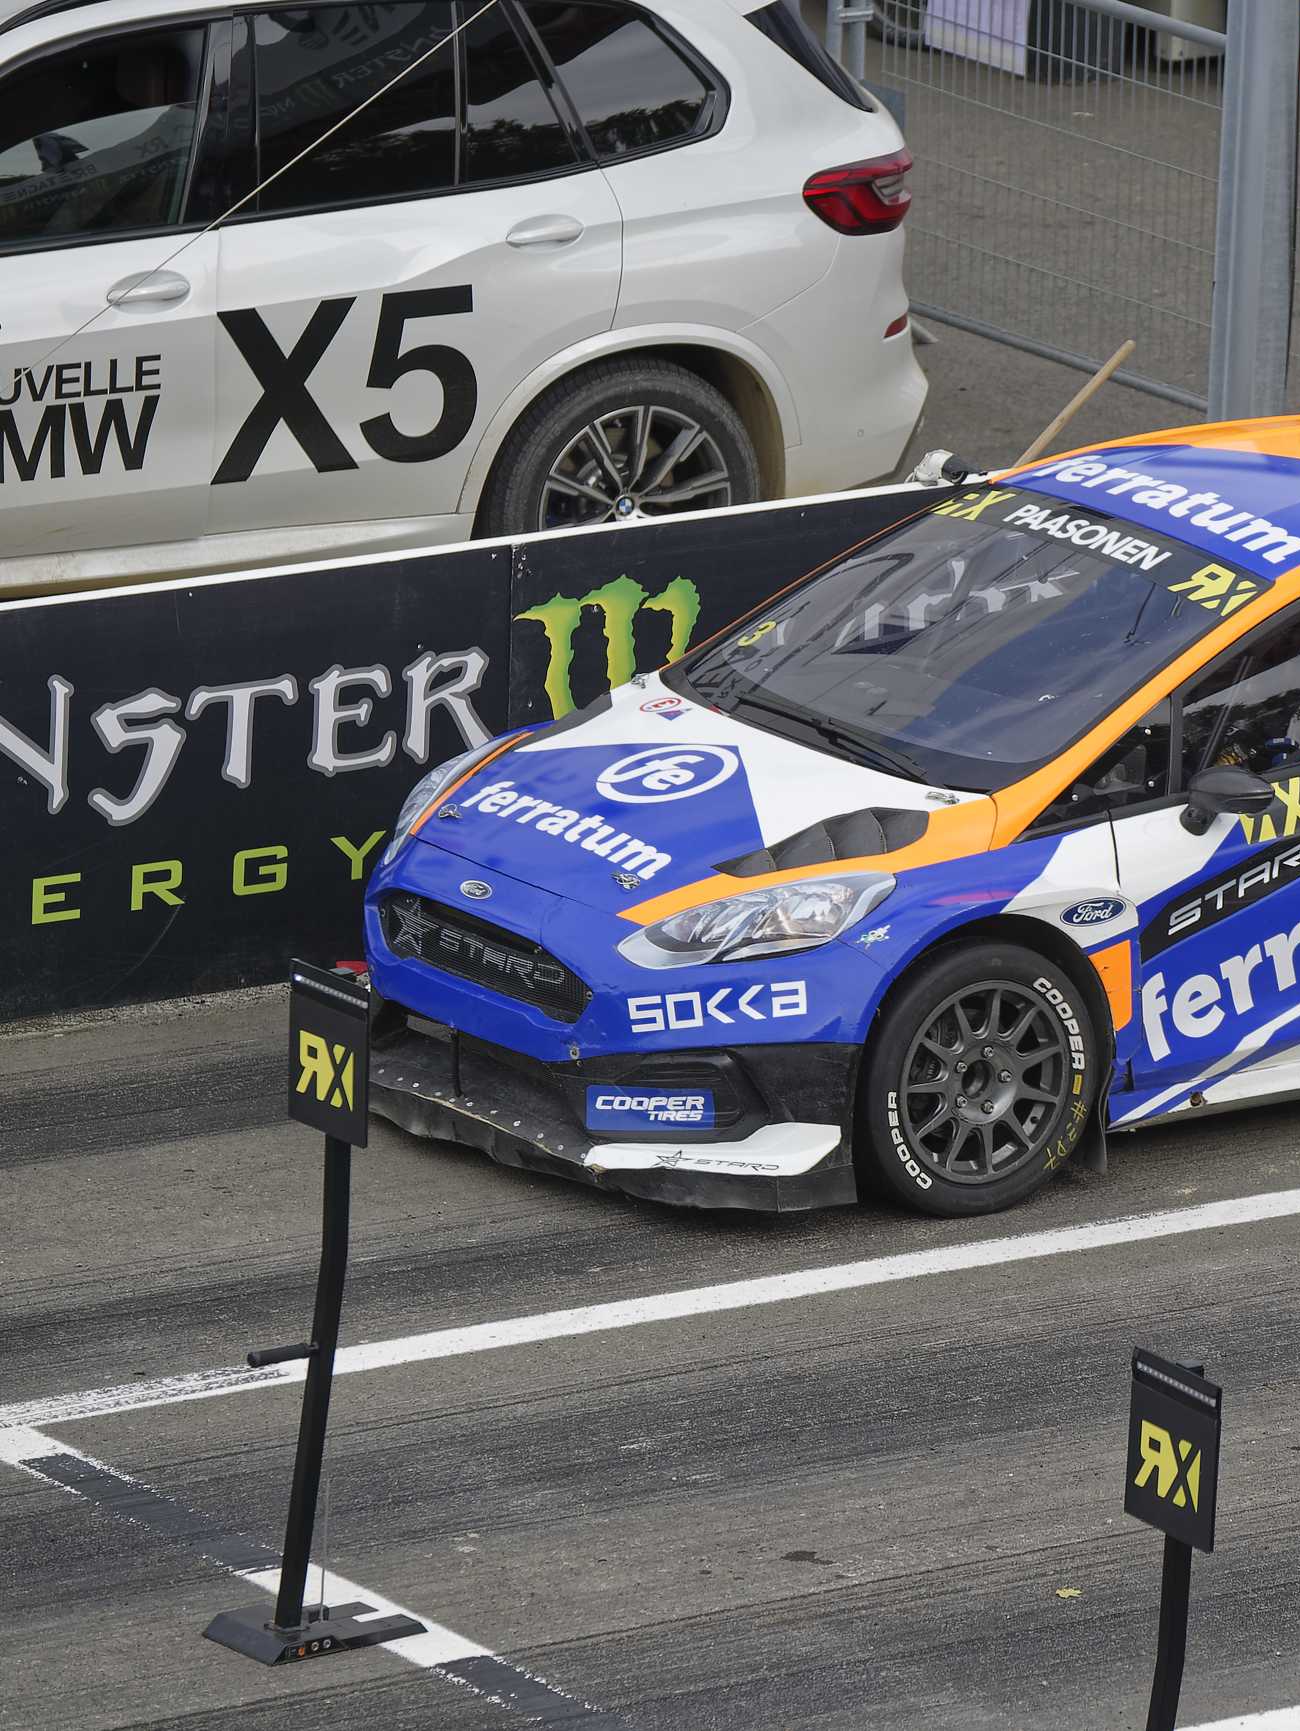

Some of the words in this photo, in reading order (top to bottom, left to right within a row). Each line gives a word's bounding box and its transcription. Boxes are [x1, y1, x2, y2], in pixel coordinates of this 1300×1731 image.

[210, 284, 478, 485] X5
[1003, 504, 1172, 571] PAASONEN
[737, 620, 777, 647] 3
[460, 781, 672, 880] ferratum
[31, 831, 386, 925] ERGY
[1072, 903, 1115, 922] Ford
[438, 928, 566, 989] STARD
[1032, 977, 1086, 1070] COOPER
[595, 1095, 705, 1111] COOPER
[647, 1110, 704, 1122] TIRES
[693, 1158, 780, 1171] STARD
[887, 1091, 933, 1190] COOPER
